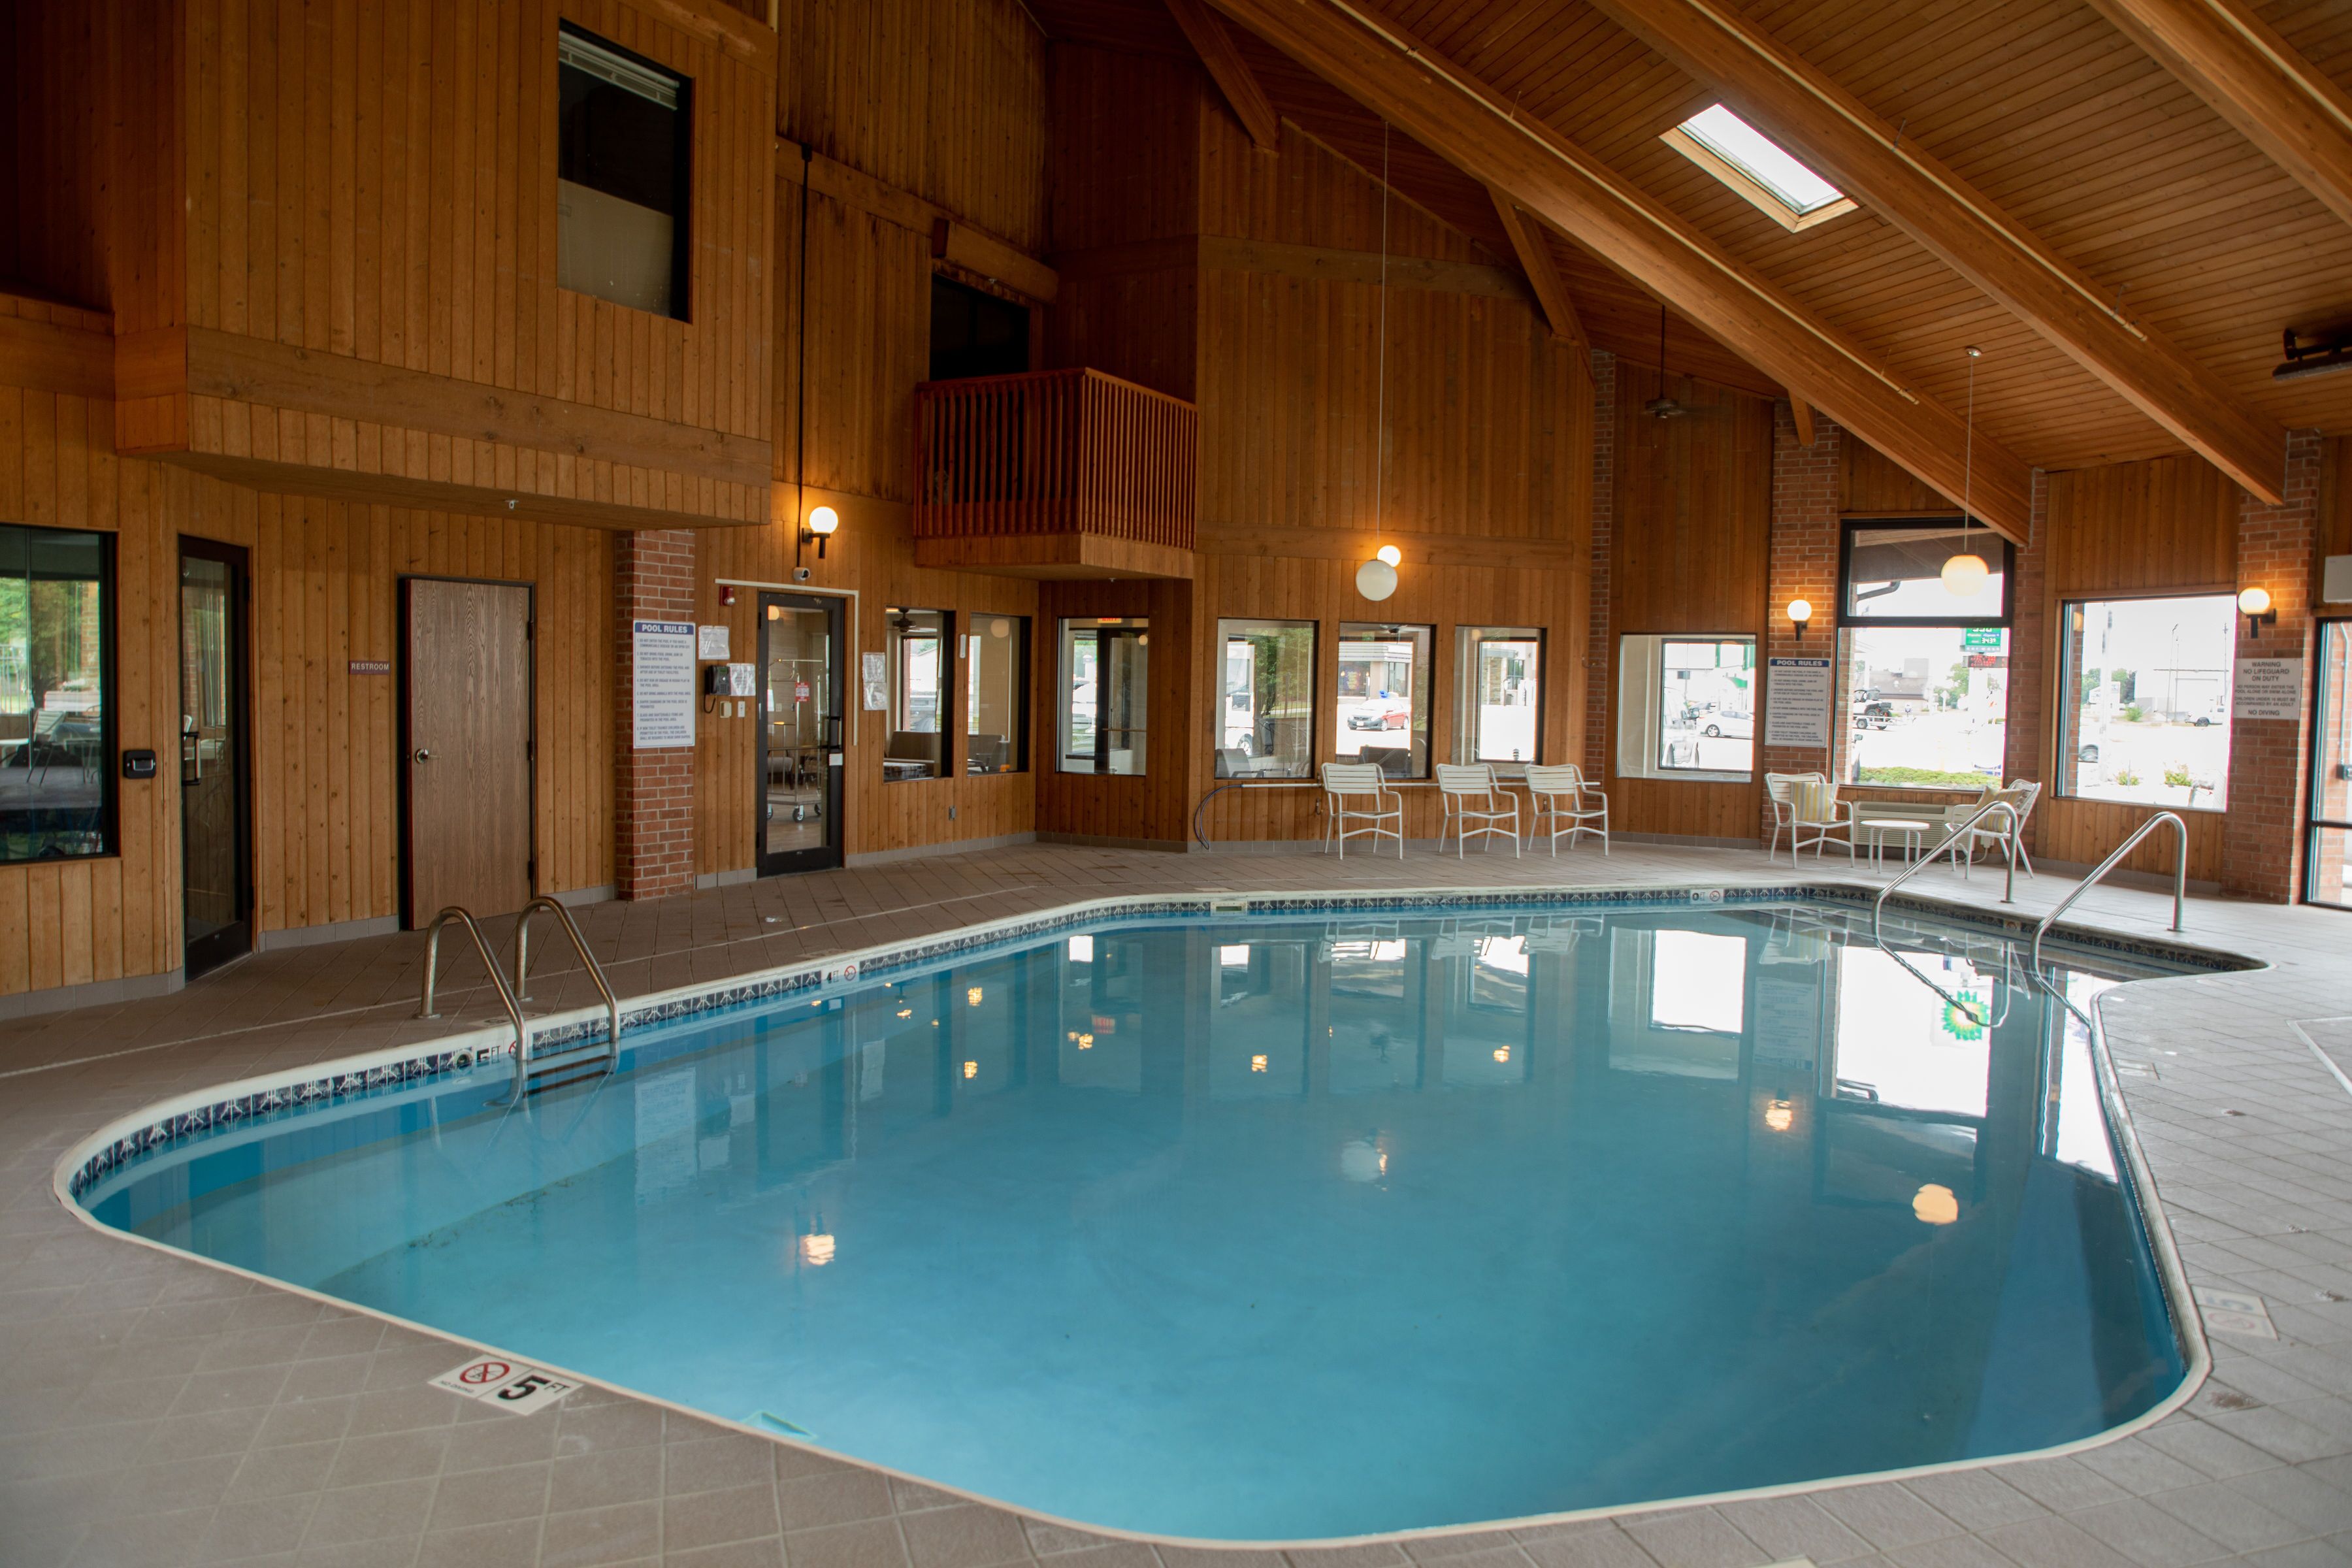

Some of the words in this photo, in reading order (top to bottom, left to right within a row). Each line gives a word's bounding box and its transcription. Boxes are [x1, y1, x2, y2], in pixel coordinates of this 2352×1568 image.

[642, 624, 662, 632] POOL
[664, 625, 688, 634] RULES
[497, 1374, 552, 1400] 5
[544, 1382, 570, 1394] FT
